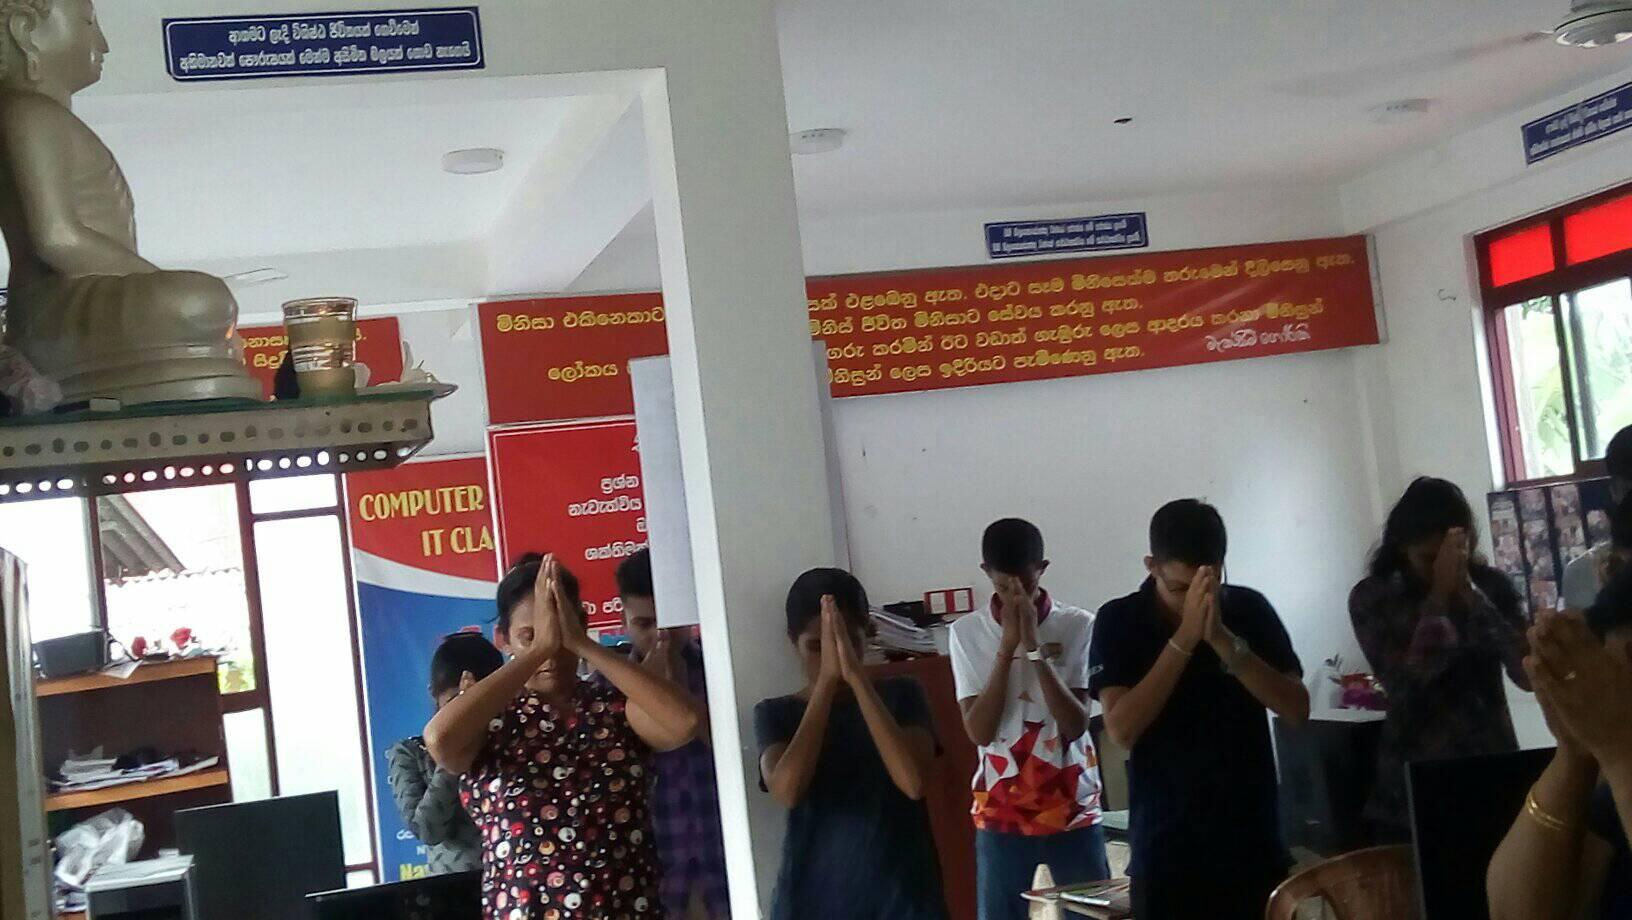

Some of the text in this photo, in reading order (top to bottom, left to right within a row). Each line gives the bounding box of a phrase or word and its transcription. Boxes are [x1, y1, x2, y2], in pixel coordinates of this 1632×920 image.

[497, 313, 555, 333] මිනිසා
[913, 308, 981, 328] මිනිසාට
[1099, 321, 1141, 338] ලෙස
[547, 360, 618, 382] ලෝකය
[889, 364, 933, 381] ලෙස
[358, 485, 485, 522] COMPUTER
[421, 529, 445, 557] IT
